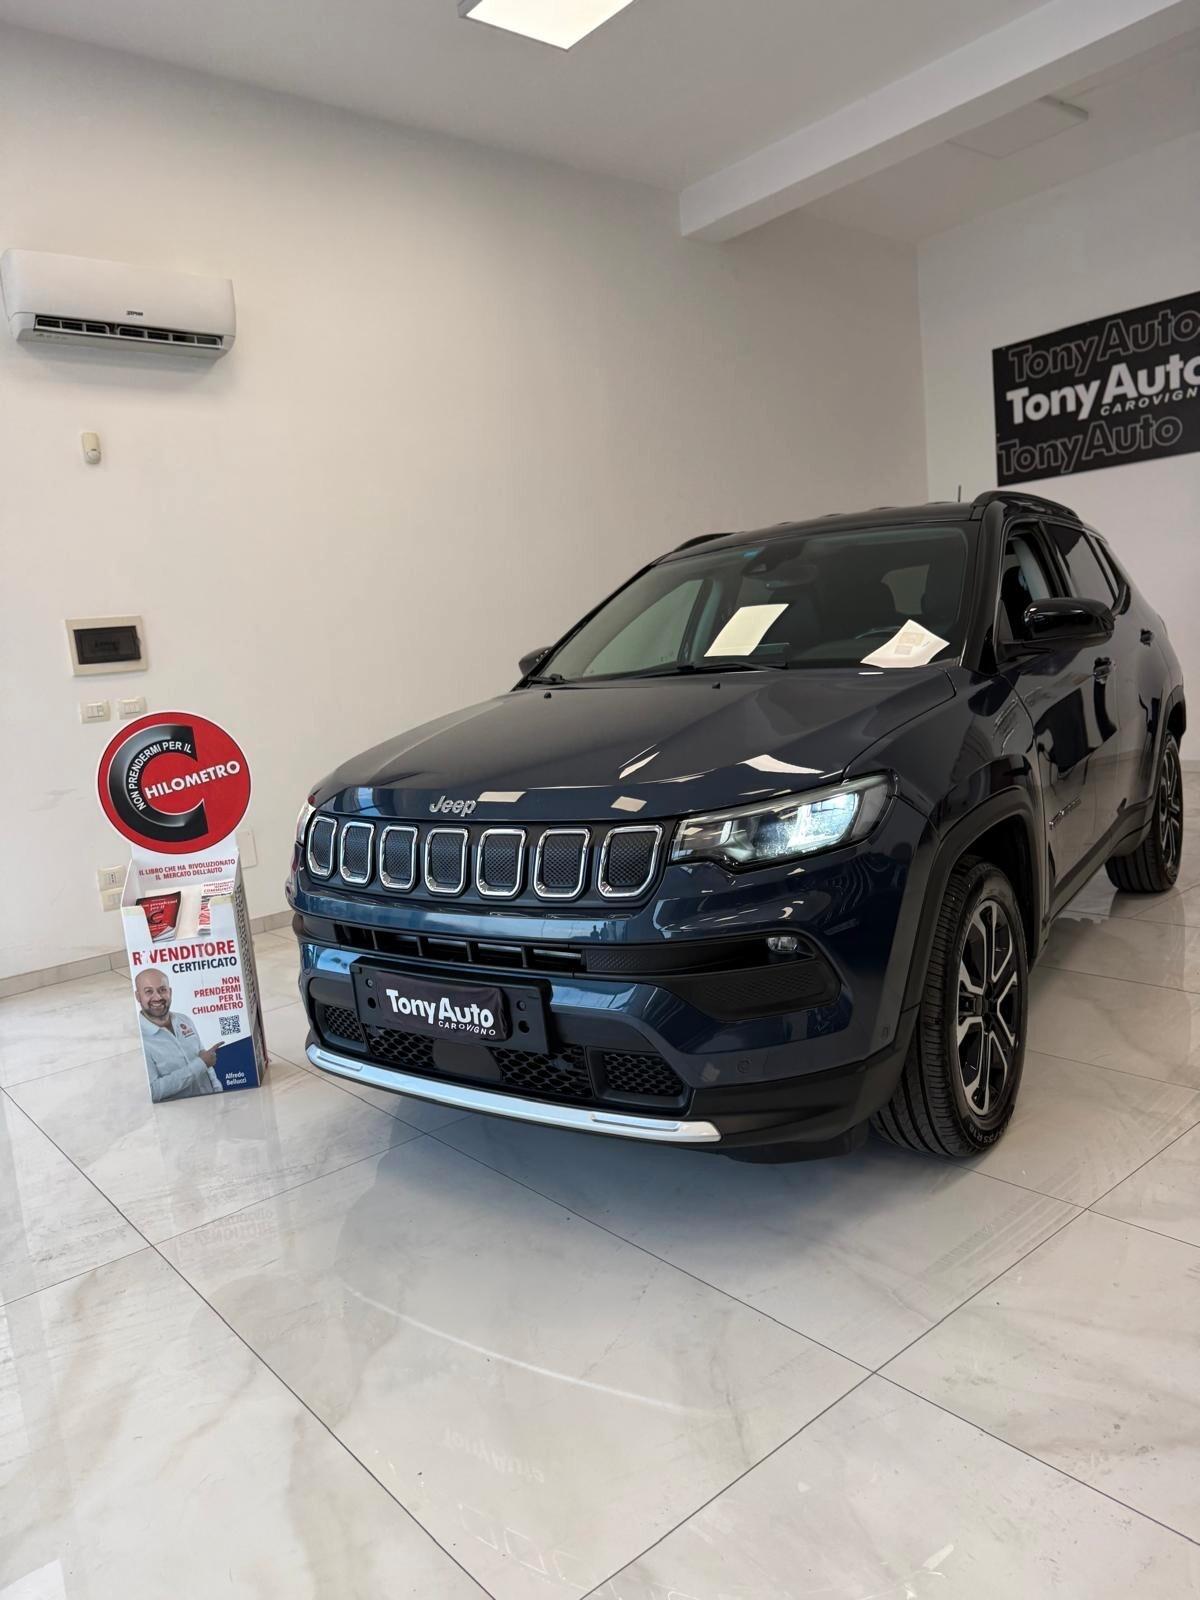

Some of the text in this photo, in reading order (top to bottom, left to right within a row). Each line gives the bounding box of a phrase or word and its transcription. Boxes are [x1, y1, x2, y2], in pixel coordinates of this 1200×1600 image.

[997, 414, 1183, 475] TonyAuto
[128, 740, 192, 811] NON PRENDERMI PER IL
[429, 795, 477, 817] Jeep
[145, 867, 164, 875] LIBRO
[188, 859, 236, 870] RIVOLUZIONATO
[163, 871, 192, 880] MERCATO
[132, 940, 236, 966] RVENDITORE
[172, 956, 238, 974] CERTIFICATO
[221, 976, 240, 985] NON
[194, 984, 241, 998] PRENDERMI
[218, 993, 243, 1003] PER IL
[192, 1001, 244, 1015] CHILOMETRO
[385, 988, 494, 1028] TonyAuto
[438, 1021, 496, 1036] CAROVIGNO
[225, 1072, 245, 1080] Alfredo
